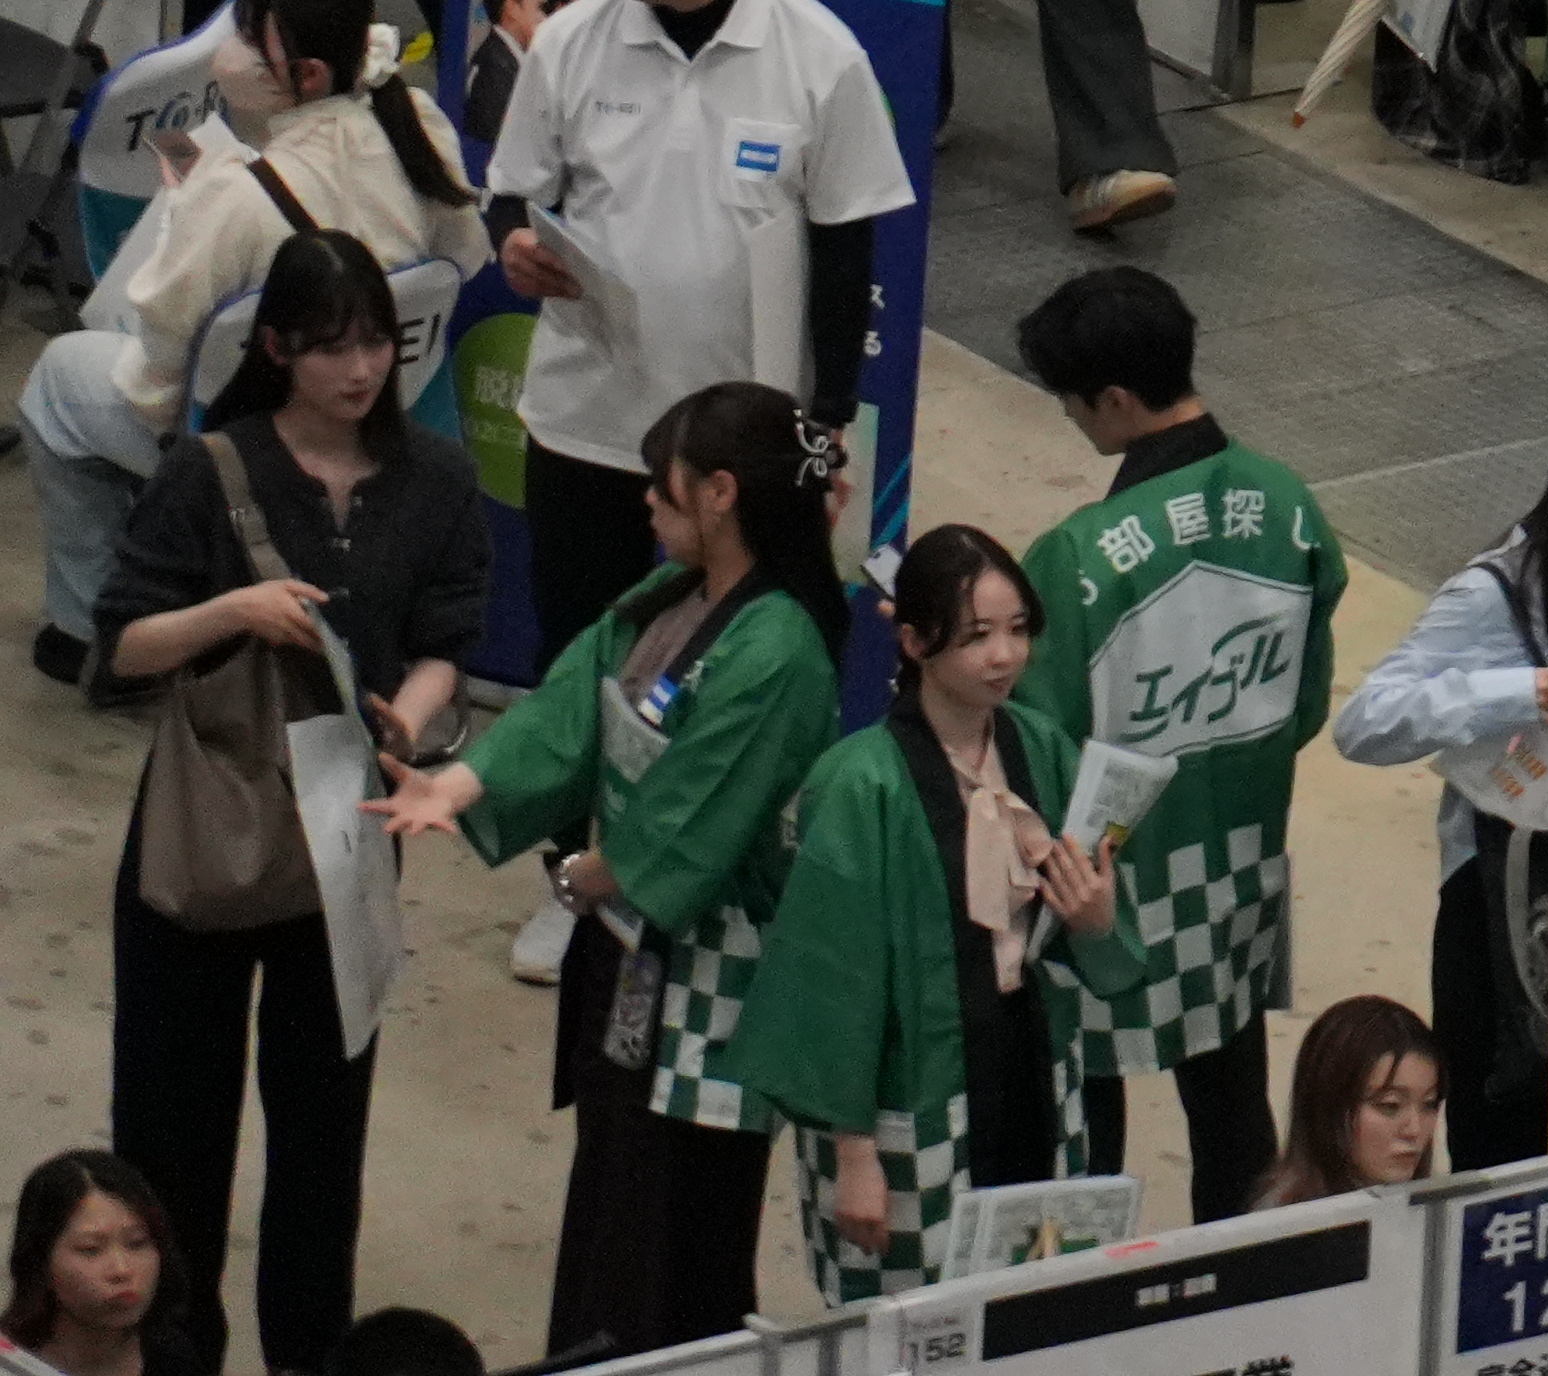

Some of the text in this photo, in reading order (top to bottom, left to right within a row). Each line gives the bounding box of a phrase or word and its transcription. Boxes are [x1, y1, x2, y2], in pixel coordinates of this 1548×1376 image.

[1125, 614, 1292, 724] エイブル
[905, 1331, 967, 1374] 152
